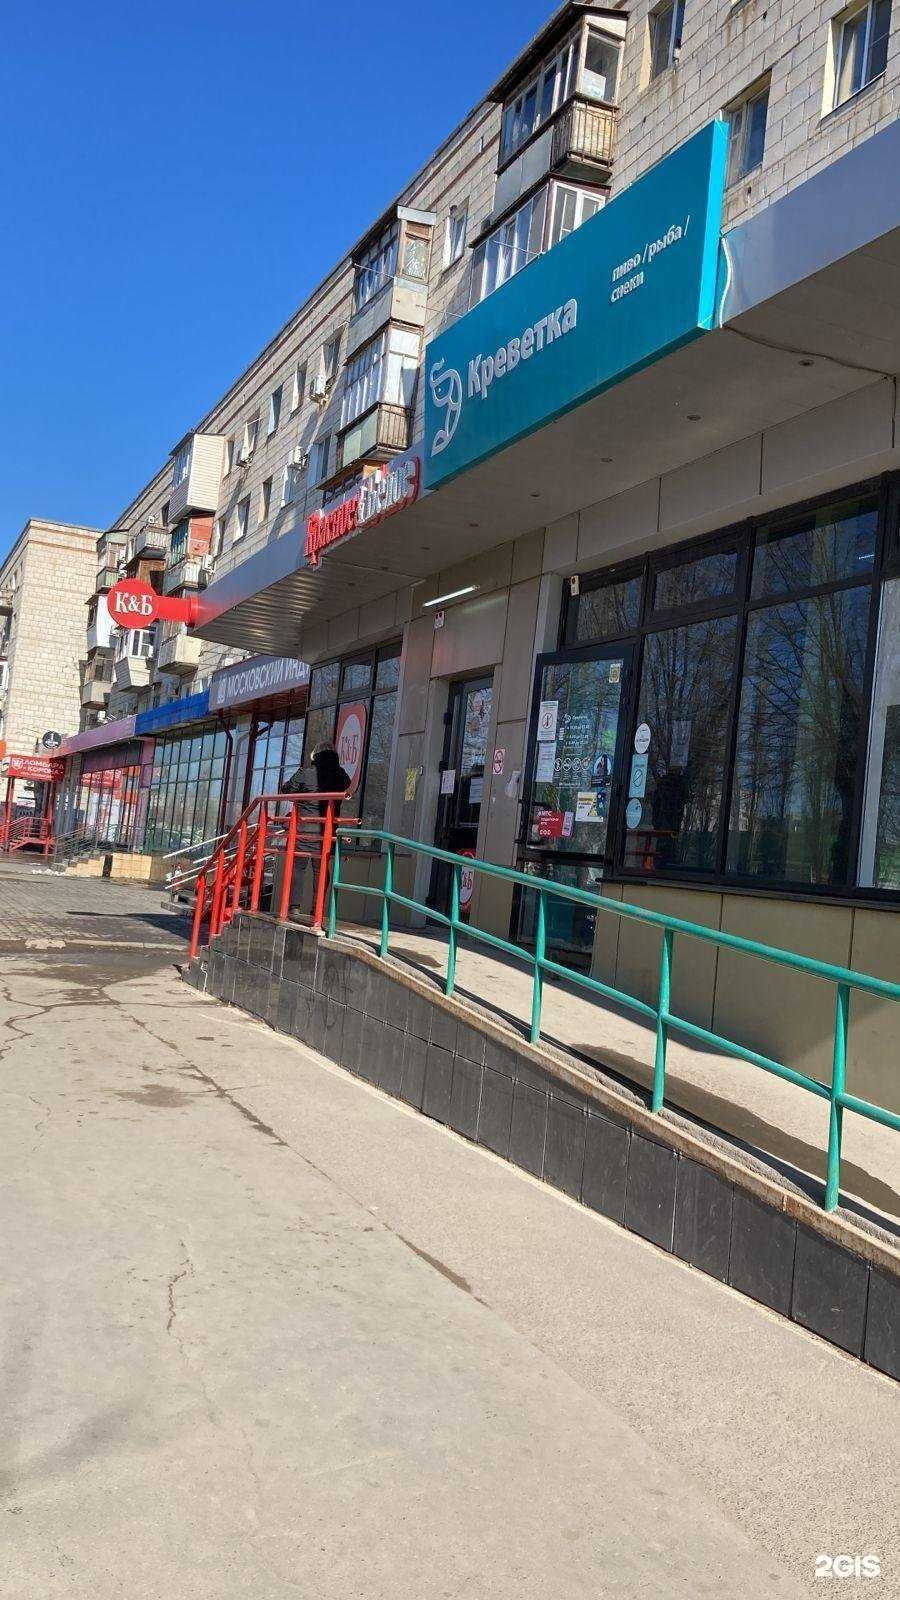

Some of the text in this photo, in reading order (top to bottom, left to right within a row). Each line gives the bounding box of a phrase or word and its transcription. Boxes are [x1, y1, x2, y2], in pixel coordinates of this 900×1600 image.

[612, 253, 641, 282] пиво
[611, 271, 644, 303] снеки
[467, 298, 578, 401] Креветка
[114, 591, 153, 616] К&Б
[226, 658, 284, 698] МОСКОВСКИЙ
